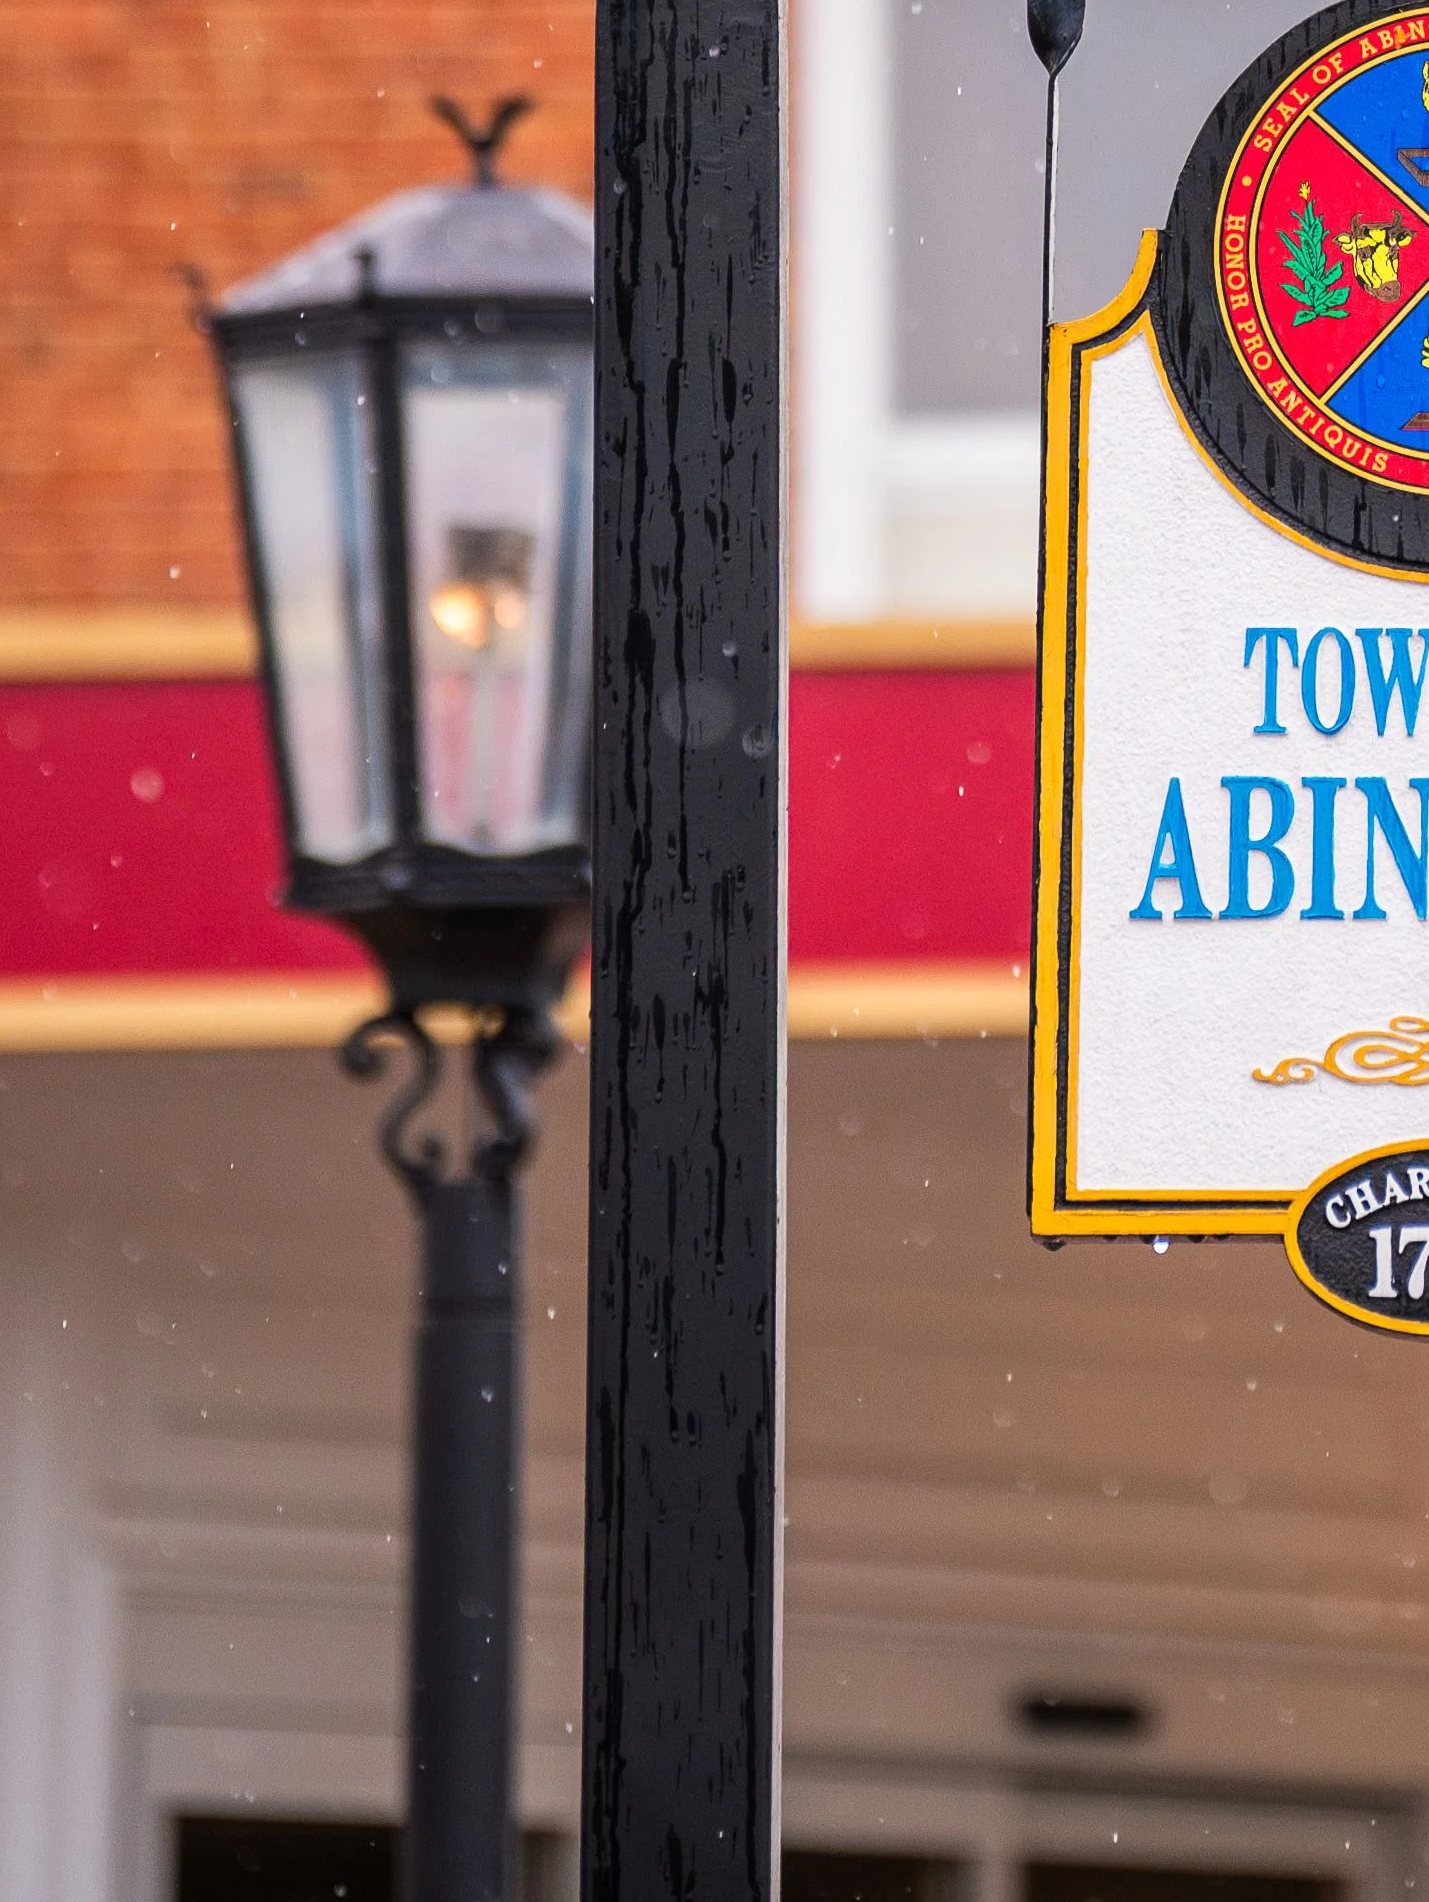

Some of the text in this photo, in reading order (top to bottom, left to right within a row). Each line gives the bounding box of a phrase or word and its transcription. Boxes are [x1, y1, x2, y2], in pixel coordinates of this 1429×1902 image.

[1253, 88, 1310, 153] SEAL
[1312, 52, 1345, 85] OF
[1222, 213, 1389, 473] HONOR PRO ANTIQUIS
